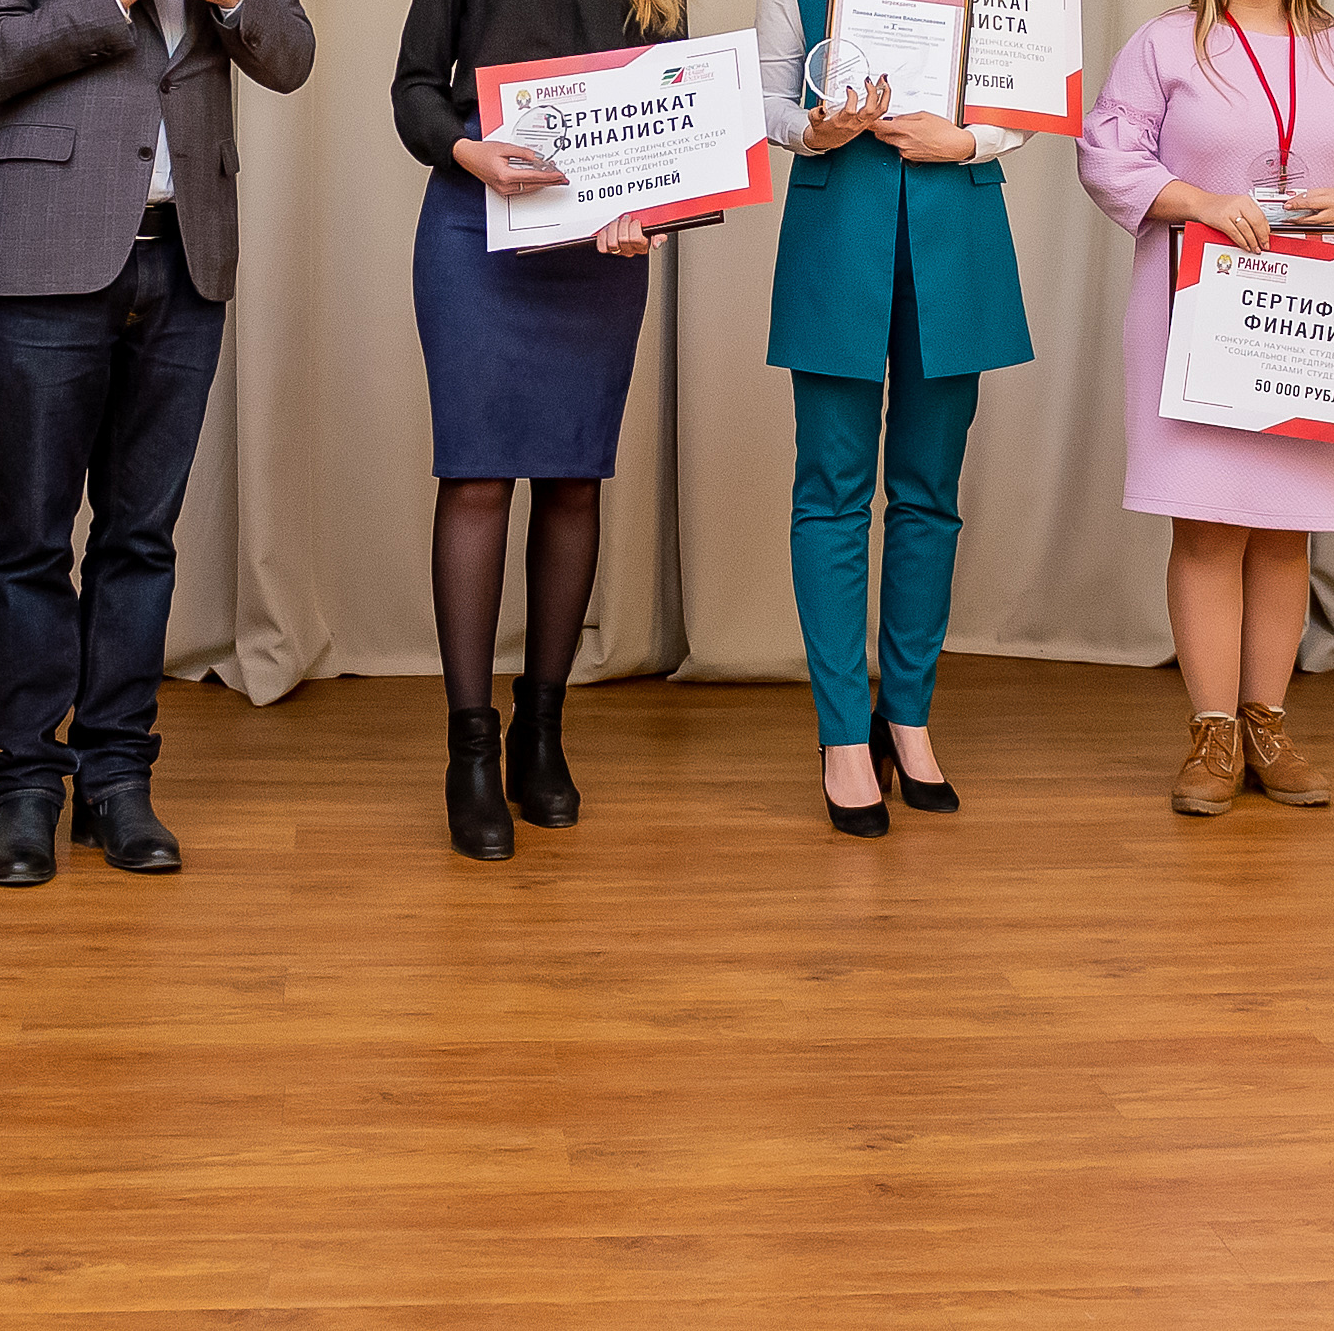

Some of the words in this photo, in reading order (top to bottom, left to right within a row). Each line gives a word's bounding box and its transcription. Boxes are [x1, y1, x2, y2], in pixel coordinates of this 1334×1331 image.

[1026, 43, 1054, 54] СТАТЕЙ
[536, 81, 587, 99] РАНХиГС
[966, 73, 1014, 90] РУБЛЕЙ
[546, 92, 697, 130] СЕРТИФИКАТ
[553, 115, 694, 151] ФИНАЛИСТА
[578, 150, 621, 163] НАУЧНЫХ
[623, 136, 691, 156] СТУДЕНЧЕСКИХ
[693, 128, 727, 142] СТАТЕЙ
[608, 140, 717, 168] ПРЕДПРИНИМАТЕЛЬСТВО
[579, 168, 622, 182] ГЛАЗАМИ
[578, 190, 594, 203] 50
[598, 184, 623, 200] 000
[627, 169, 680, 194] РУБЛЕЙ
[1237, 256, 1289, 275] РАНХиГС
[1214, 334, 1261, 348] КОНКУРСА
[1263, 342, 1306, 354] НАУЧНЫХ
[1260, 362, 1303, 375] ГЛАЗАМИ
[1254, 378, 1271, 393] 50
[1275, 381, 1300, 397] 000
